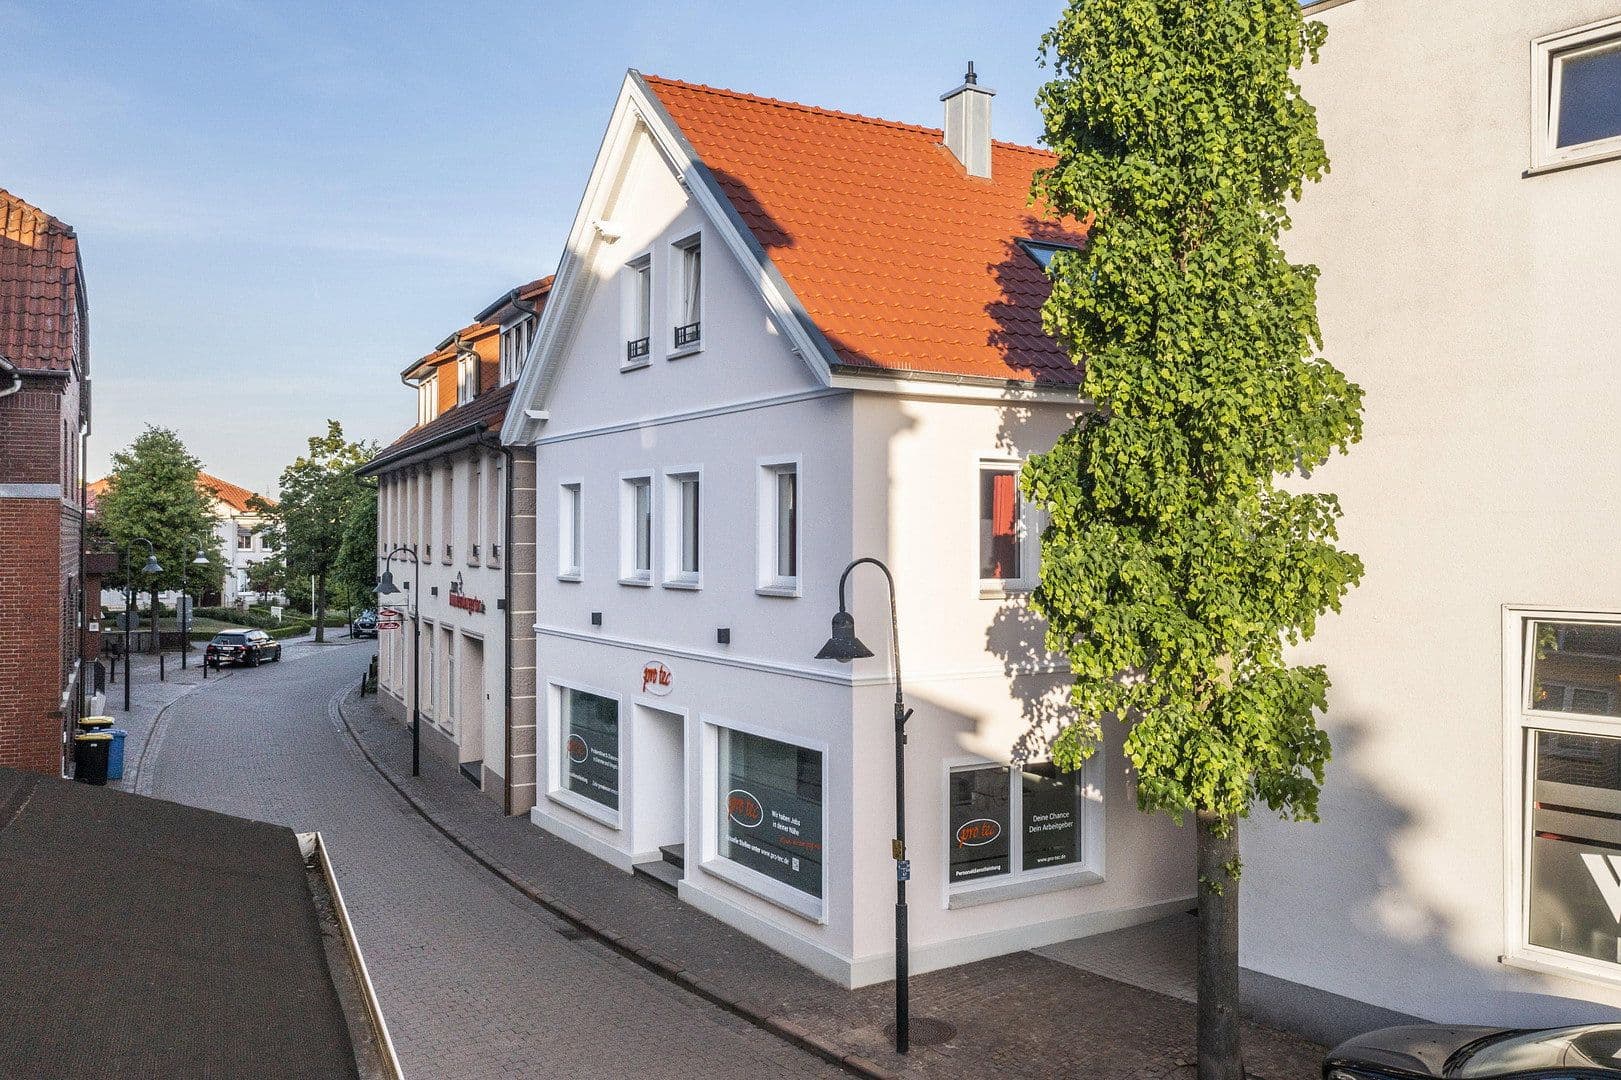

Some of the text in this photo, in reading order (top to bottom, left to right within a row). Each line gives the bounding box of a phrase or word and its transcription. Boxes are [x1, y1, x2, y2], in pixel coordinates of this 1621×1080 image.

[1033, 812, 1070, 822] Deine Chance
[1029, 821, 1074, 833] Dein Arbeitgeber
